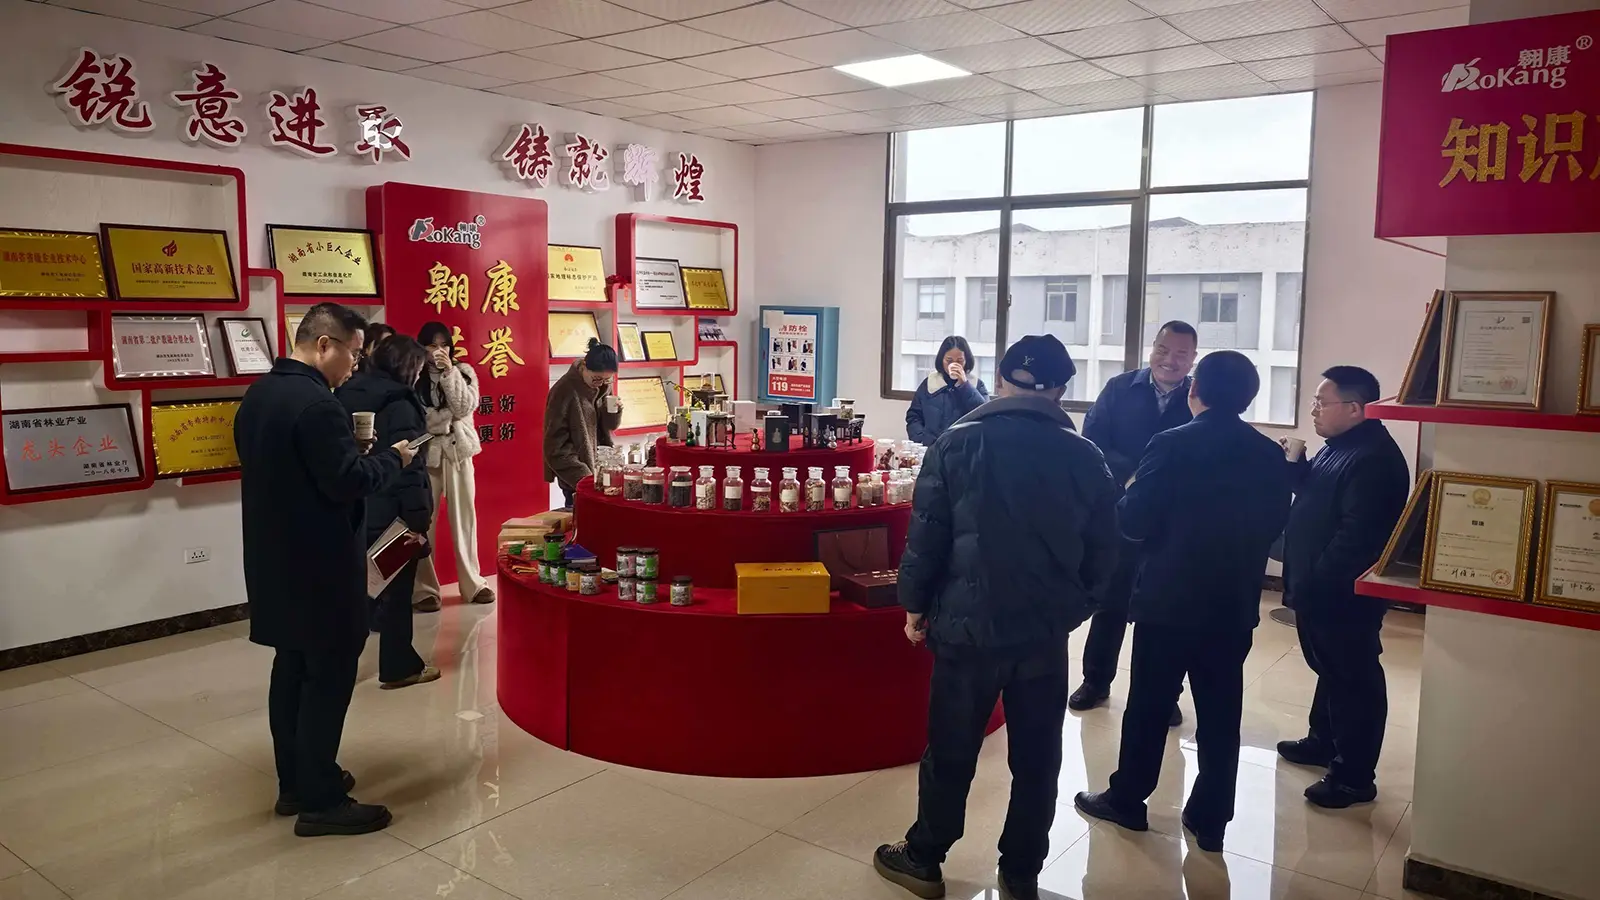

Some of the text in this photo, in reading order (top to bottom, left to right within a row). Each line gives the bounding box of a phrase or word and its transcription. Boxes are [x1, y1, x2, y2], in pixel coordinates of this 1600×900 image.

[54, 46, 706, 202] 锐意进取 铸就辉煌
[1439, 110, 1600, 188] 知识
[287, 241, 362, 266] 湖南省小巨人企业
[131, 262, 215, 276] 国家高新技术企业
[547, 273, 598, 281] 家地理标志保护产品
[424, 260, 520, 316] 翱康
[771, 381, 788, 392] 119
[478, 394, 516, 416] 最好
[9, 416, 87, 429] 湖南省林业产业
[478, 422, 516, 443] 更好
[22, 433, 118, 462] 龙头企业
[83, 459, 129, 470] 湖南省林业厅
